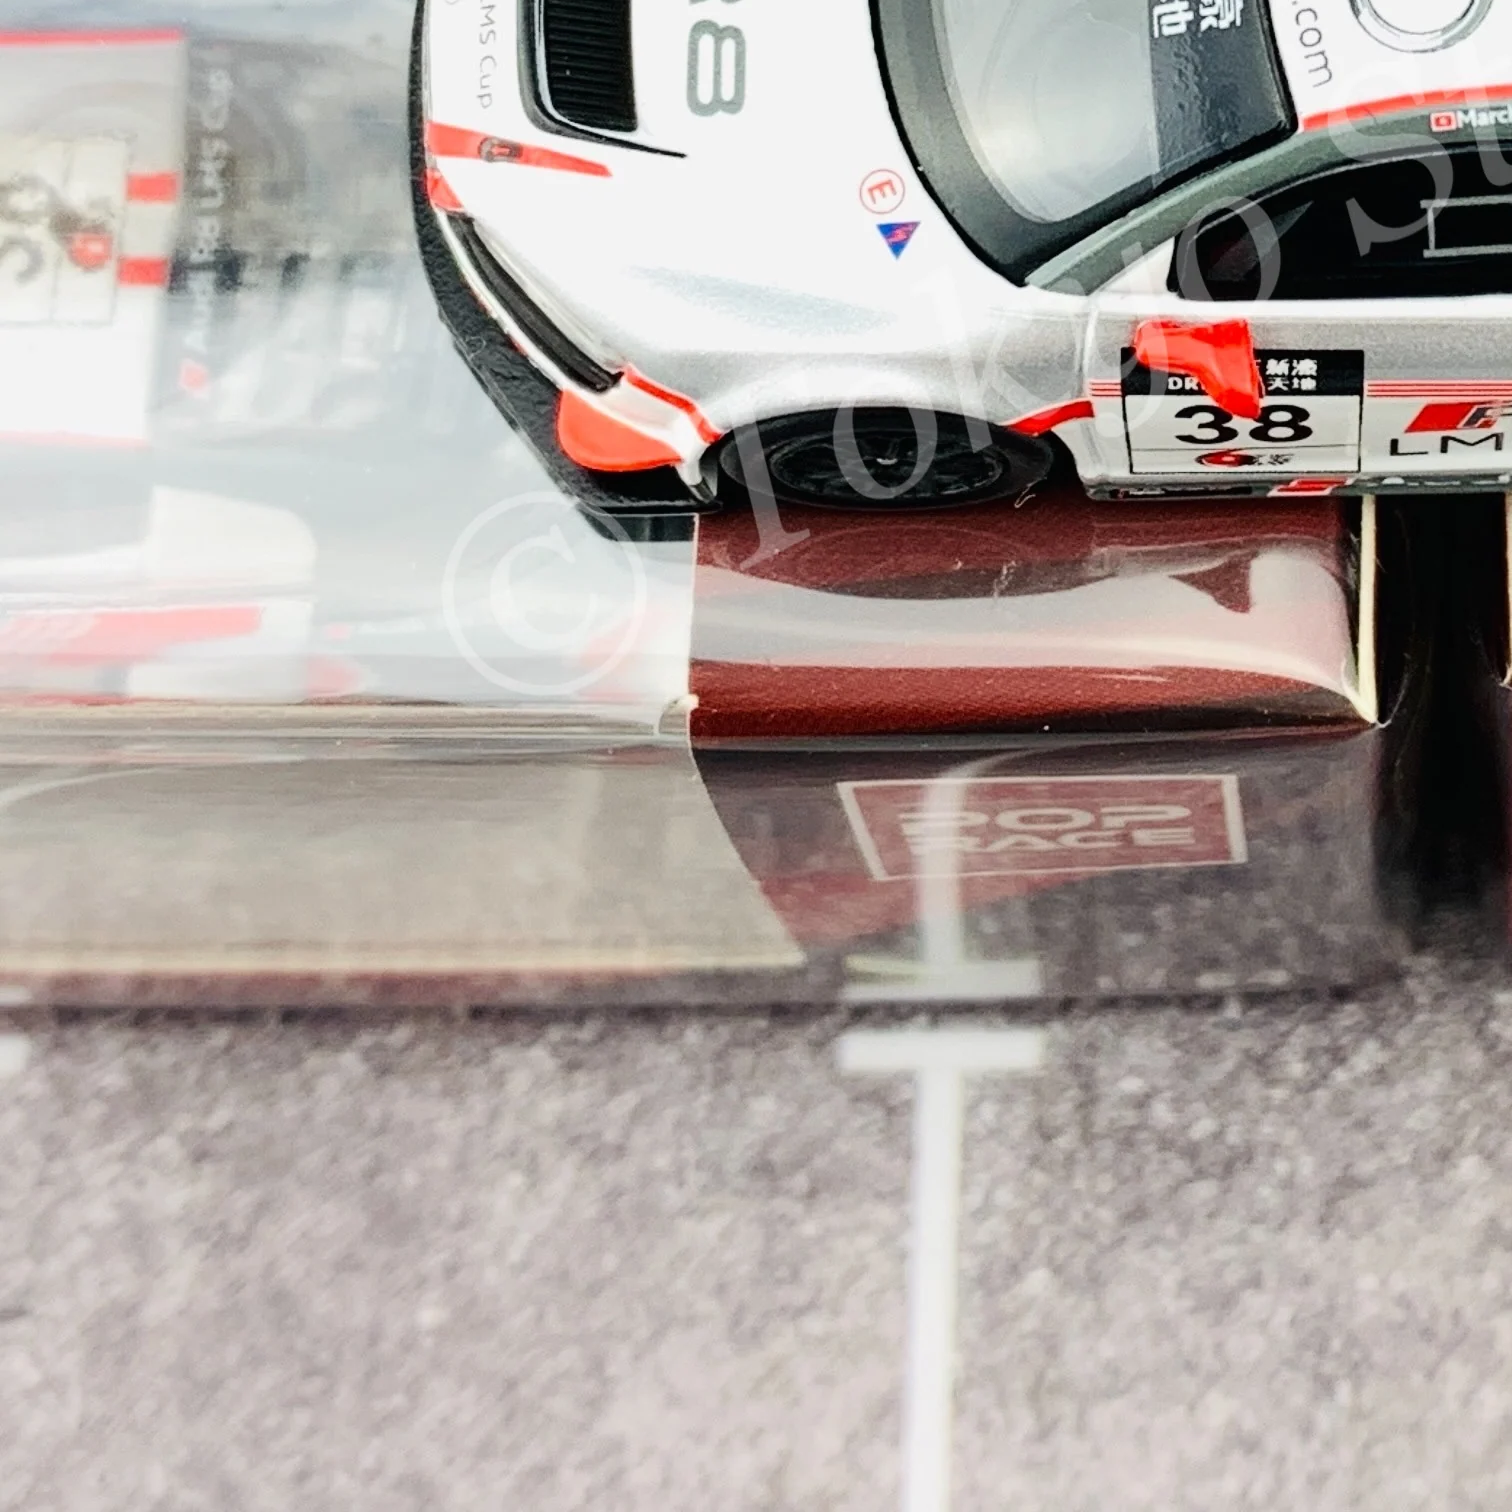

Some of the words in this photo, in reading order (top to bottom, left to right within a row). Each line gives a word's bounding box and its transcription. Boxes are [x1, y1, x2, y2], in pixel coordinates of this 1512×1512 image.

[476, 54, 498, 109] Cup
[1174, 404, 1313, 445] 38
[908, 826, 1199, 856] RACE
